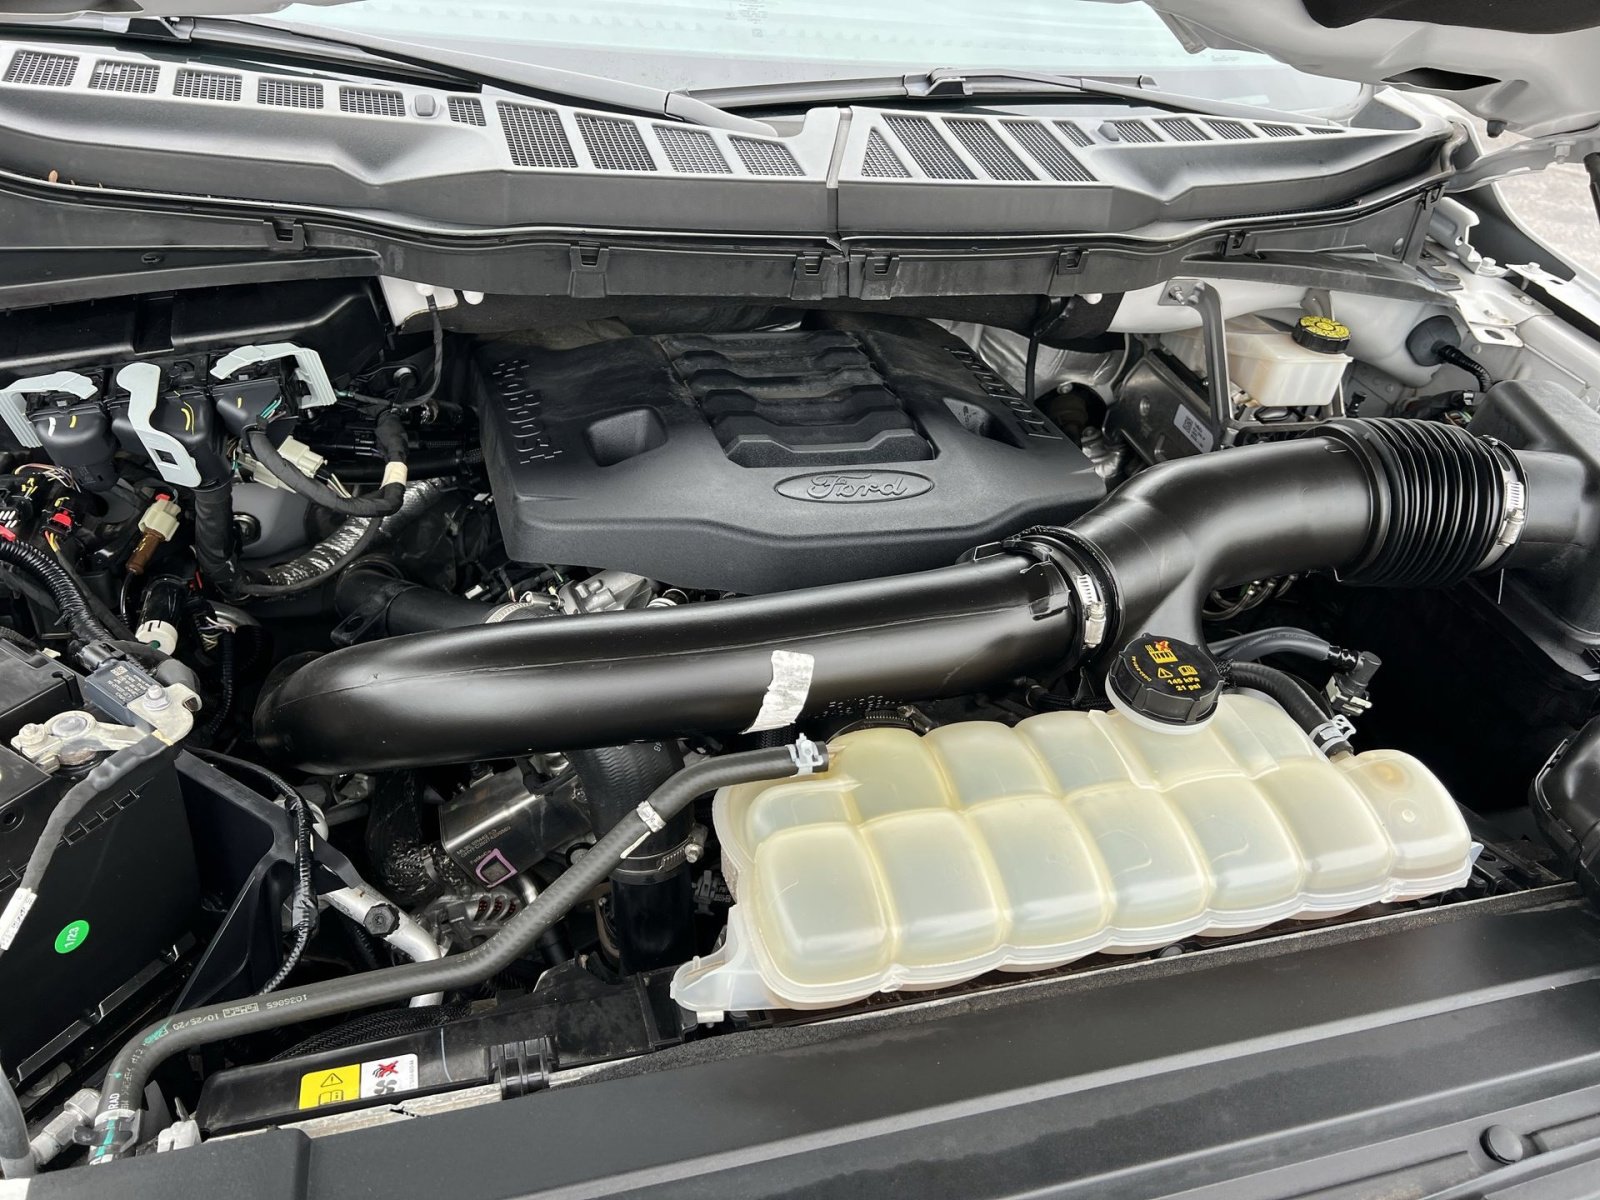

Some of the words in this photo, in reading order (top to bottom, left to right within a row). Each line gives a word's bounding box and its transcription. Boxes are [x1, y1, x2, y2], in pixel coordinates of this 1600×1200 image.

[806, 473, 908, 499] Ford
[64, 926, 80, 950] 1/23
[107, 1092, 120, 1111] RAD
